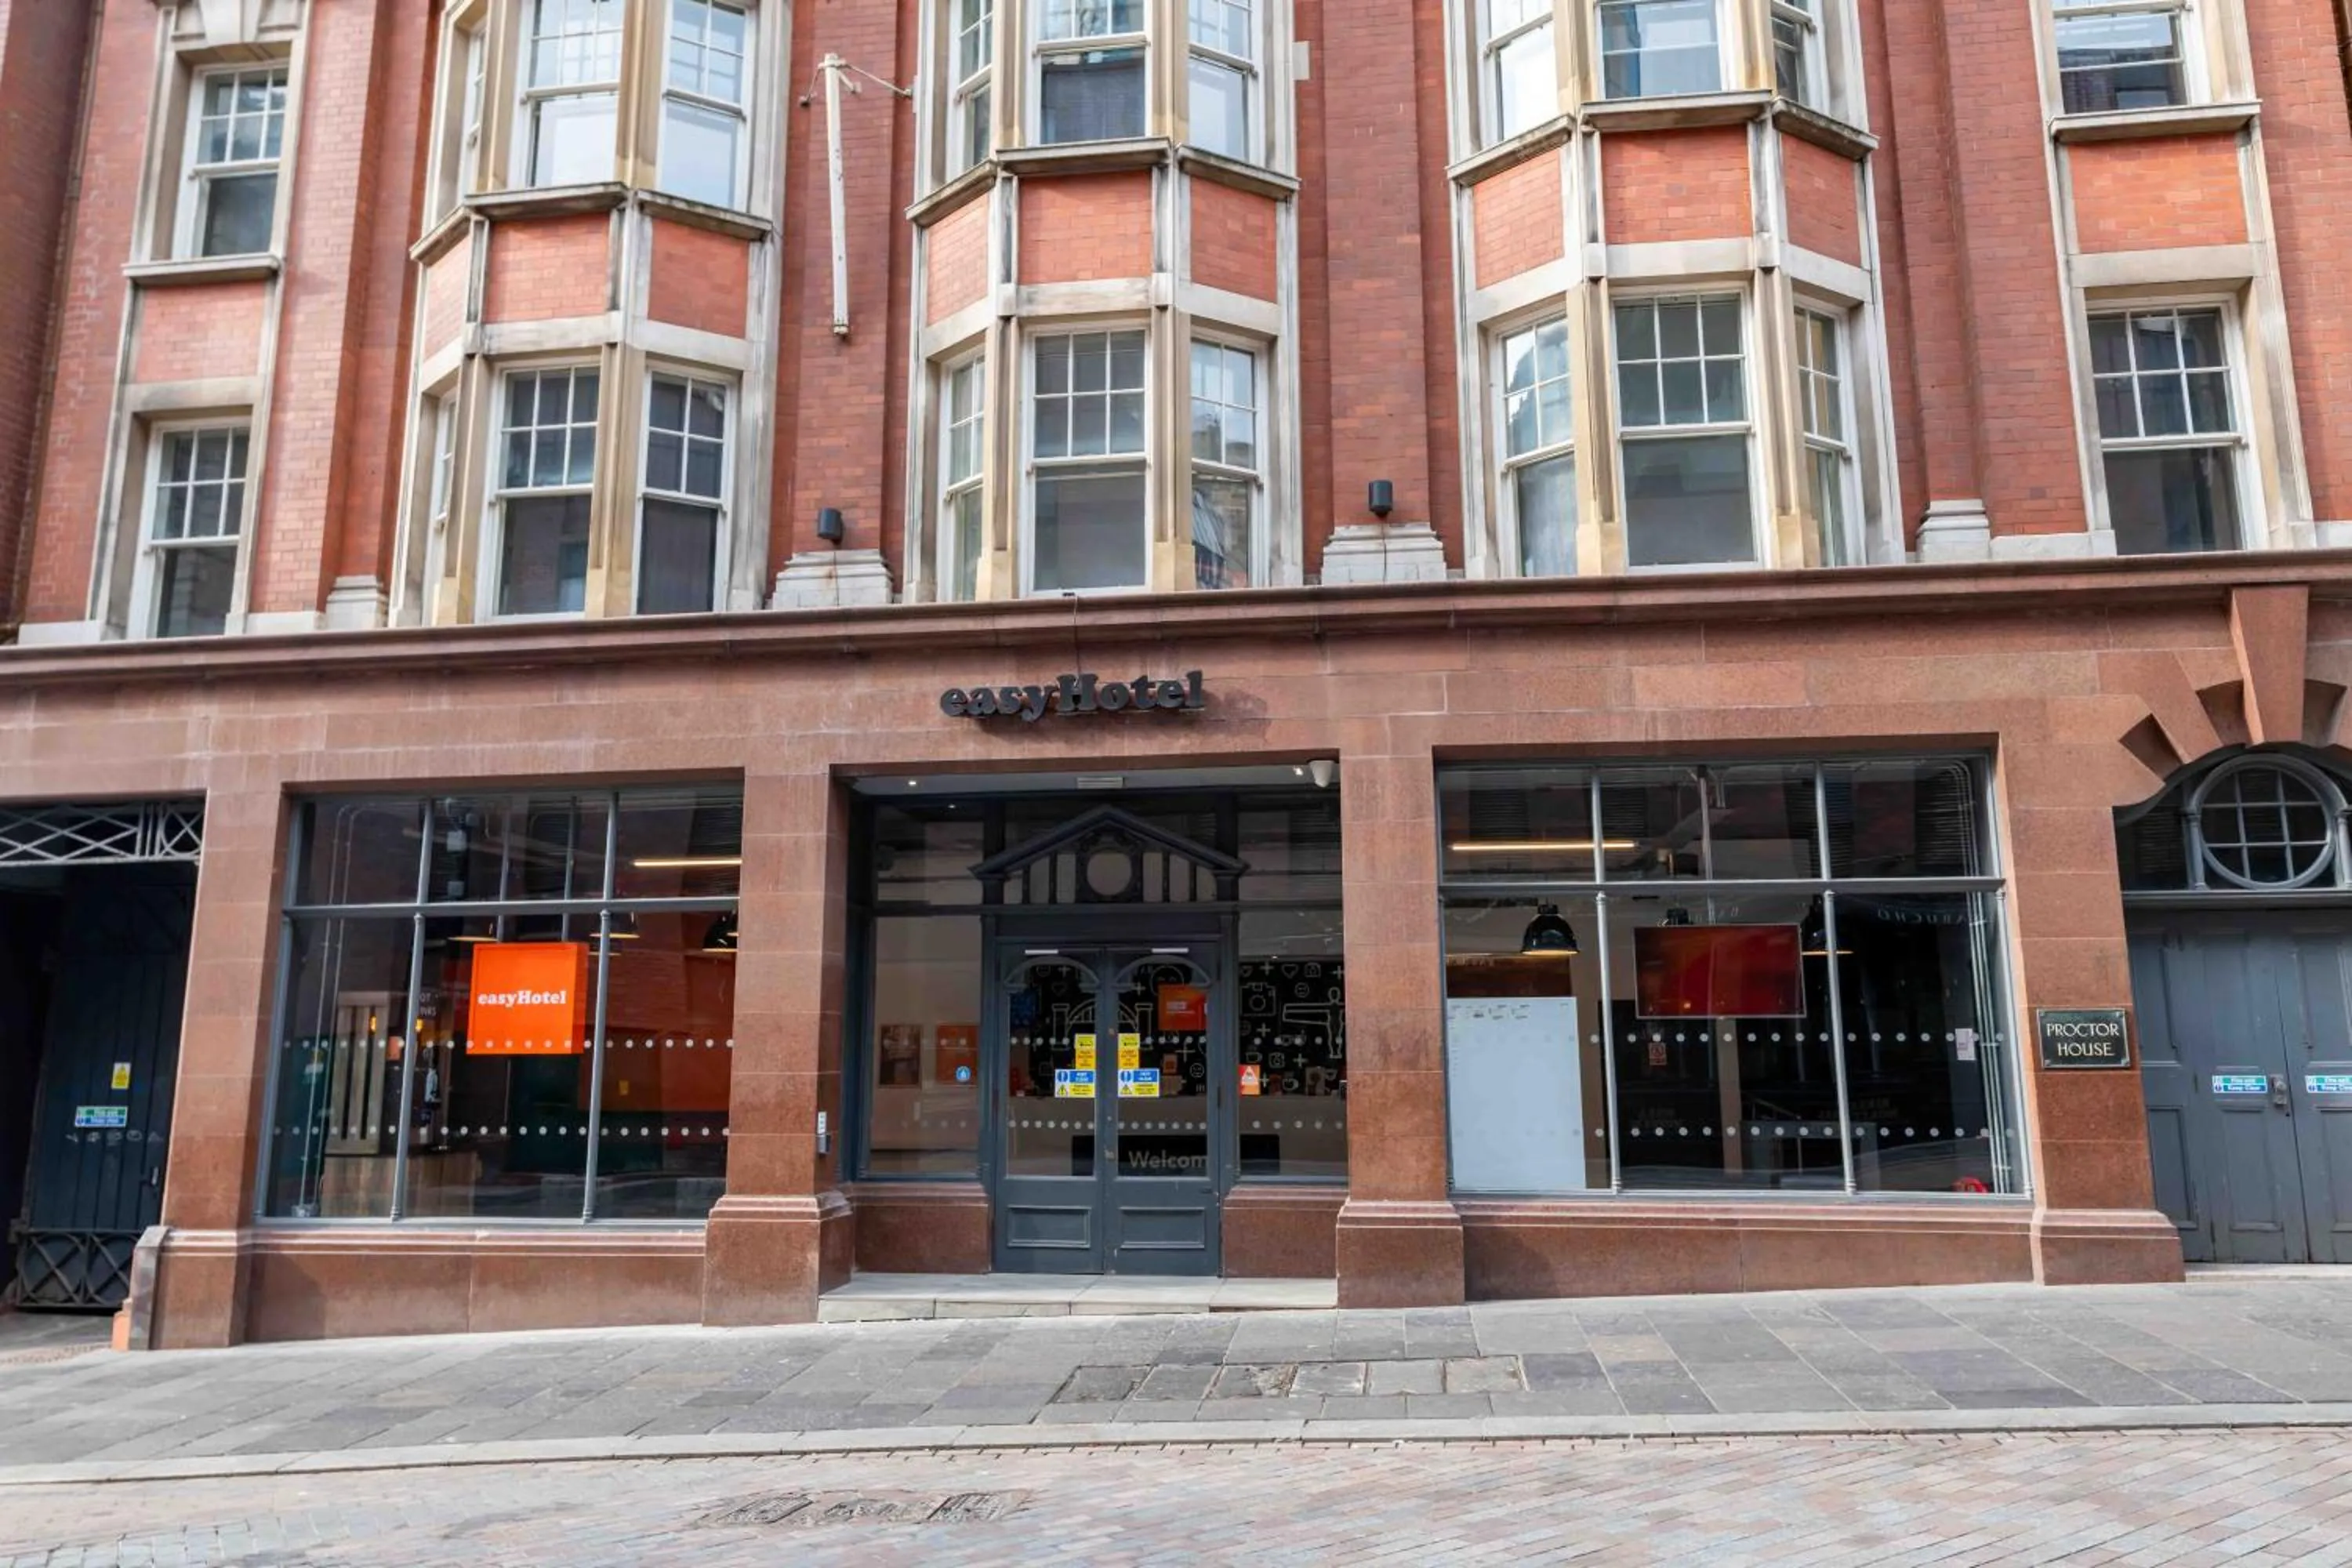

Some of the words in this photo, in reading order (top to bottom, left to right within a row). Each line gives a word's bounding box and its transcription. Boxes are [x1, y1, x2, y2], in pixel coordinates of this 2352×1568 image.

[940, 670, 1203, 722] easyHotel
[477, 989, 567, 1007] easyHotel
[2046, 1023, 2119, 1036] PROCTOR
[2057, 1042, 2114, 1056] HOUSE
[1128, 1149, 1208, 1169] Welcom
